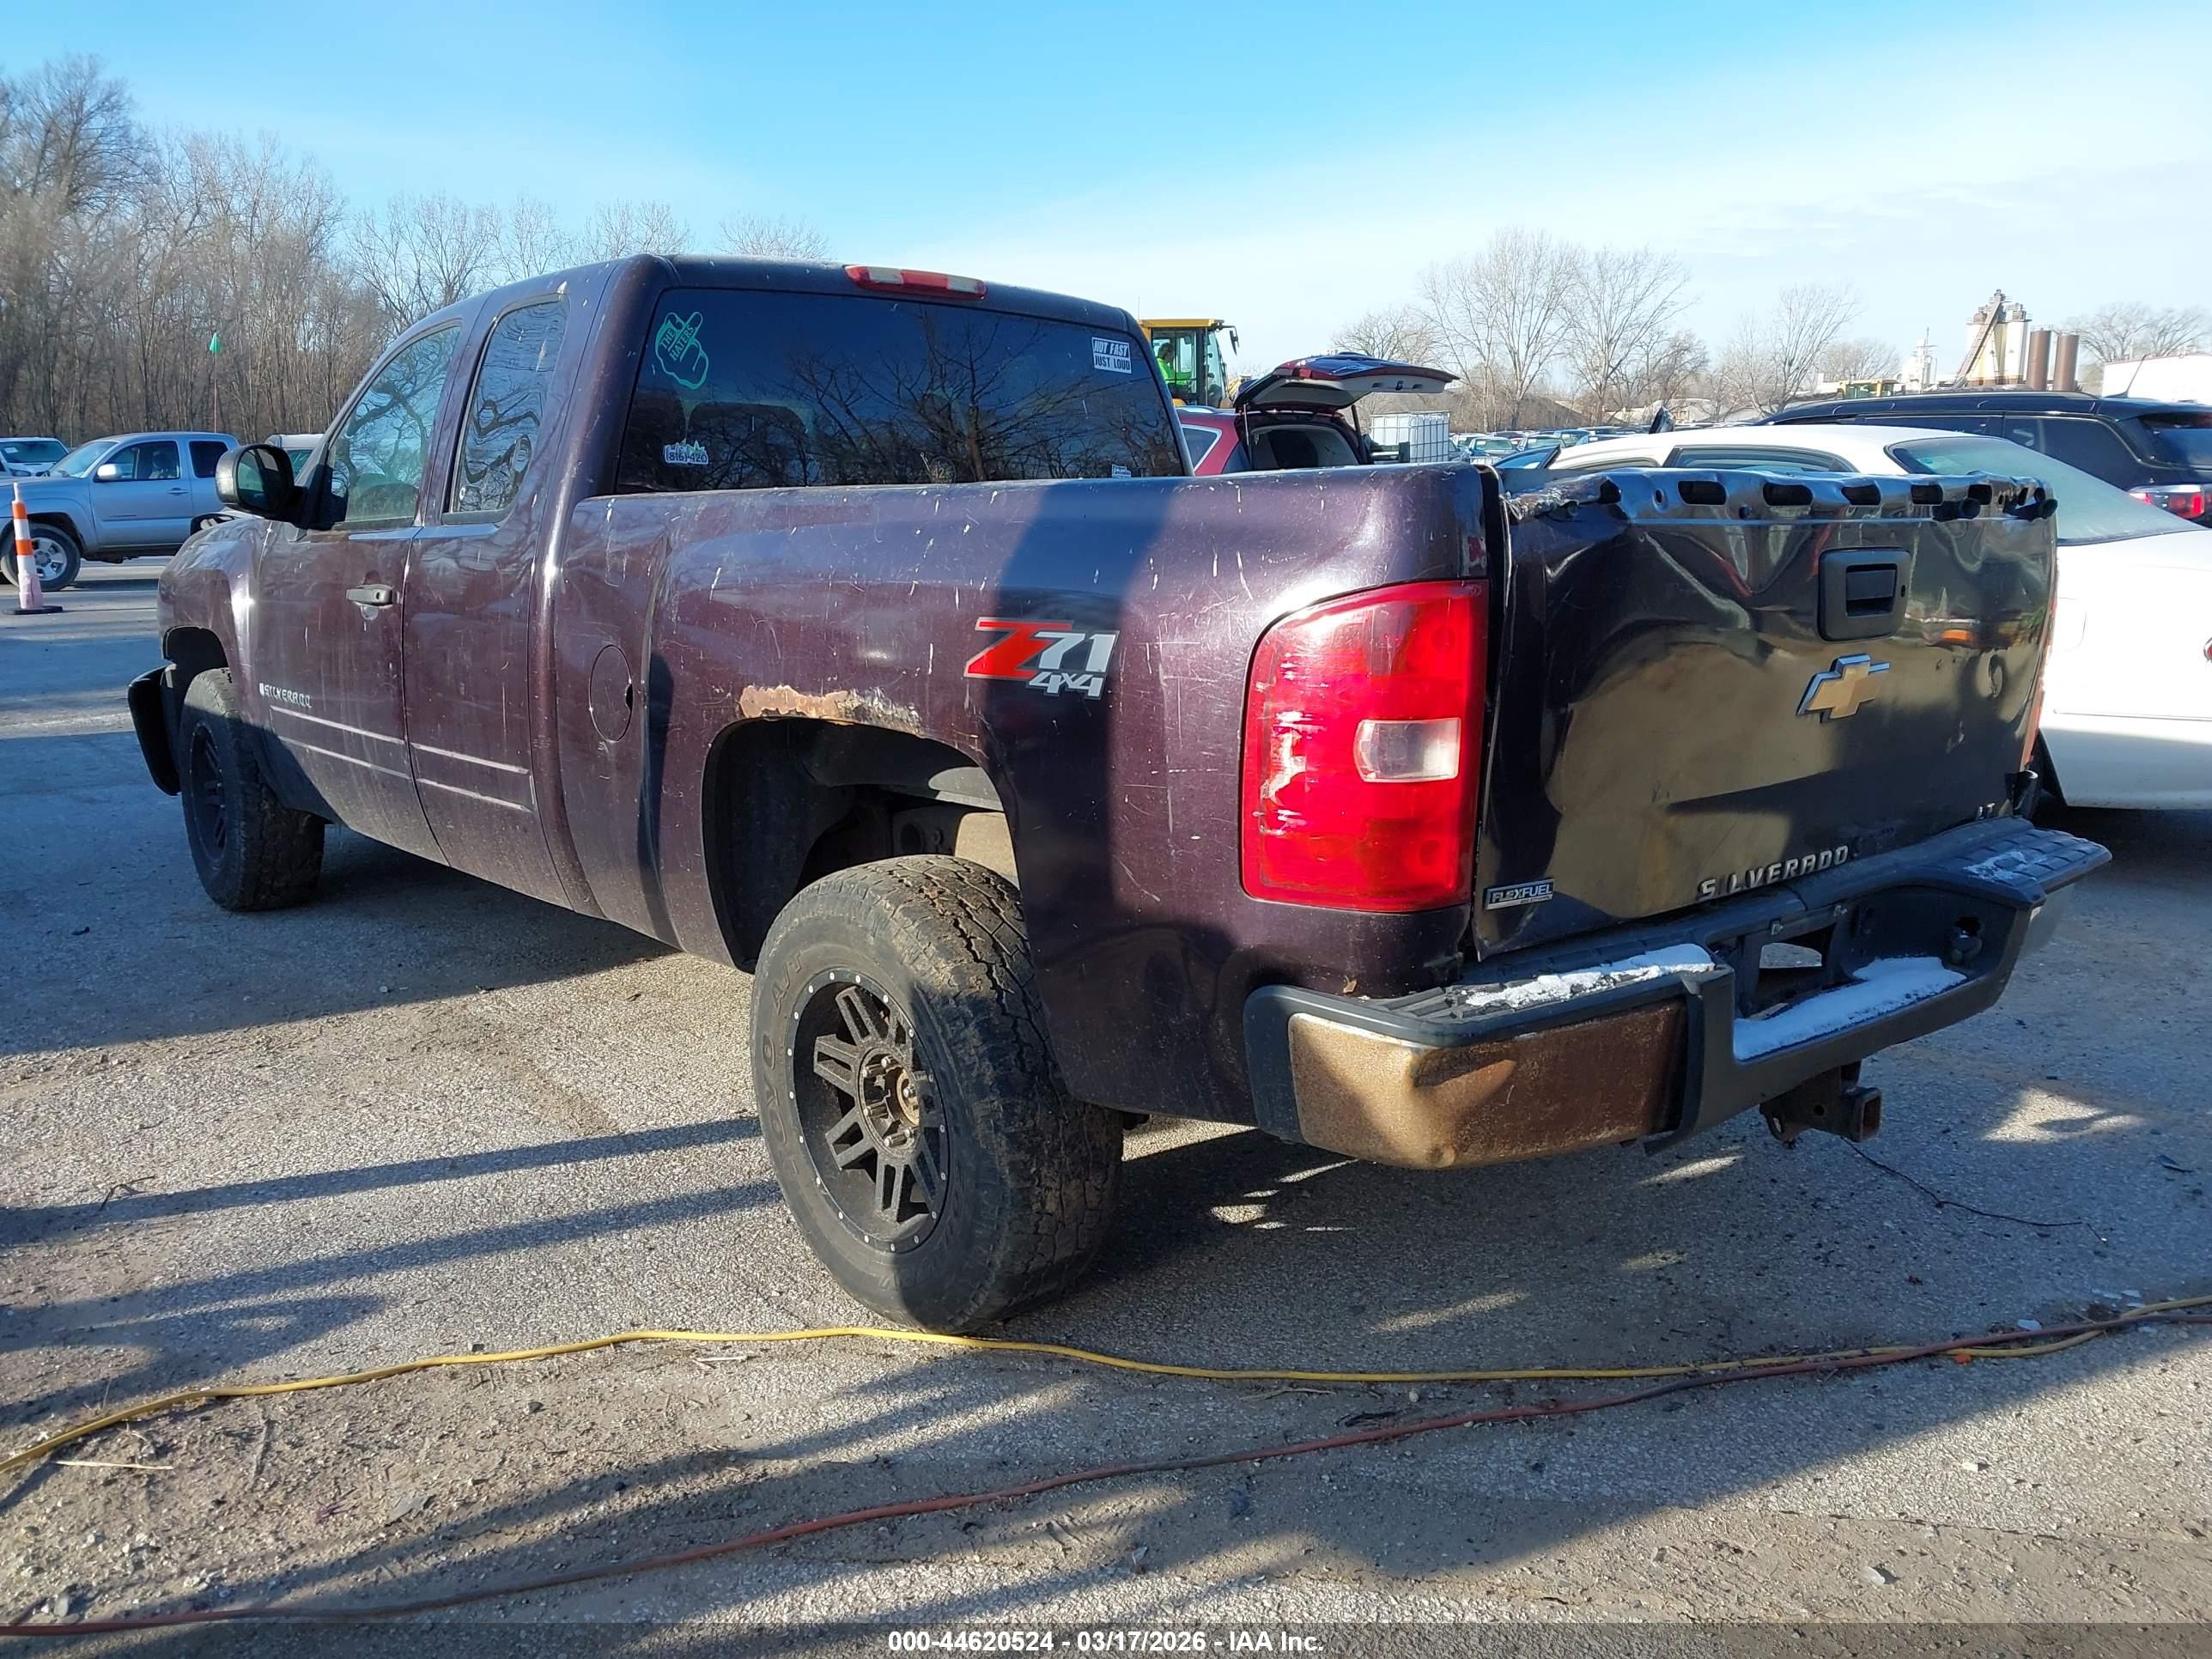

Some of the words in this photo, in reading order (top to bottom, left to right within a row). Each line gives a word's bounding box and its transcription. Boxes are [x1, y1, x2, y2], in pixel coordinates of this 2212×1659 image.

[659, 328, 676, 349] THE
[669, 325, 694, 362] HATERS
[1094, 340, 1108, 353] NOT
[1109, 343, 1128, 356] FAST
[1114, 358, 1131, 370] LOUD
[963, 617, 1120, 679] Z71
[1492, 884, 1553, 903] FLEXFUEL
